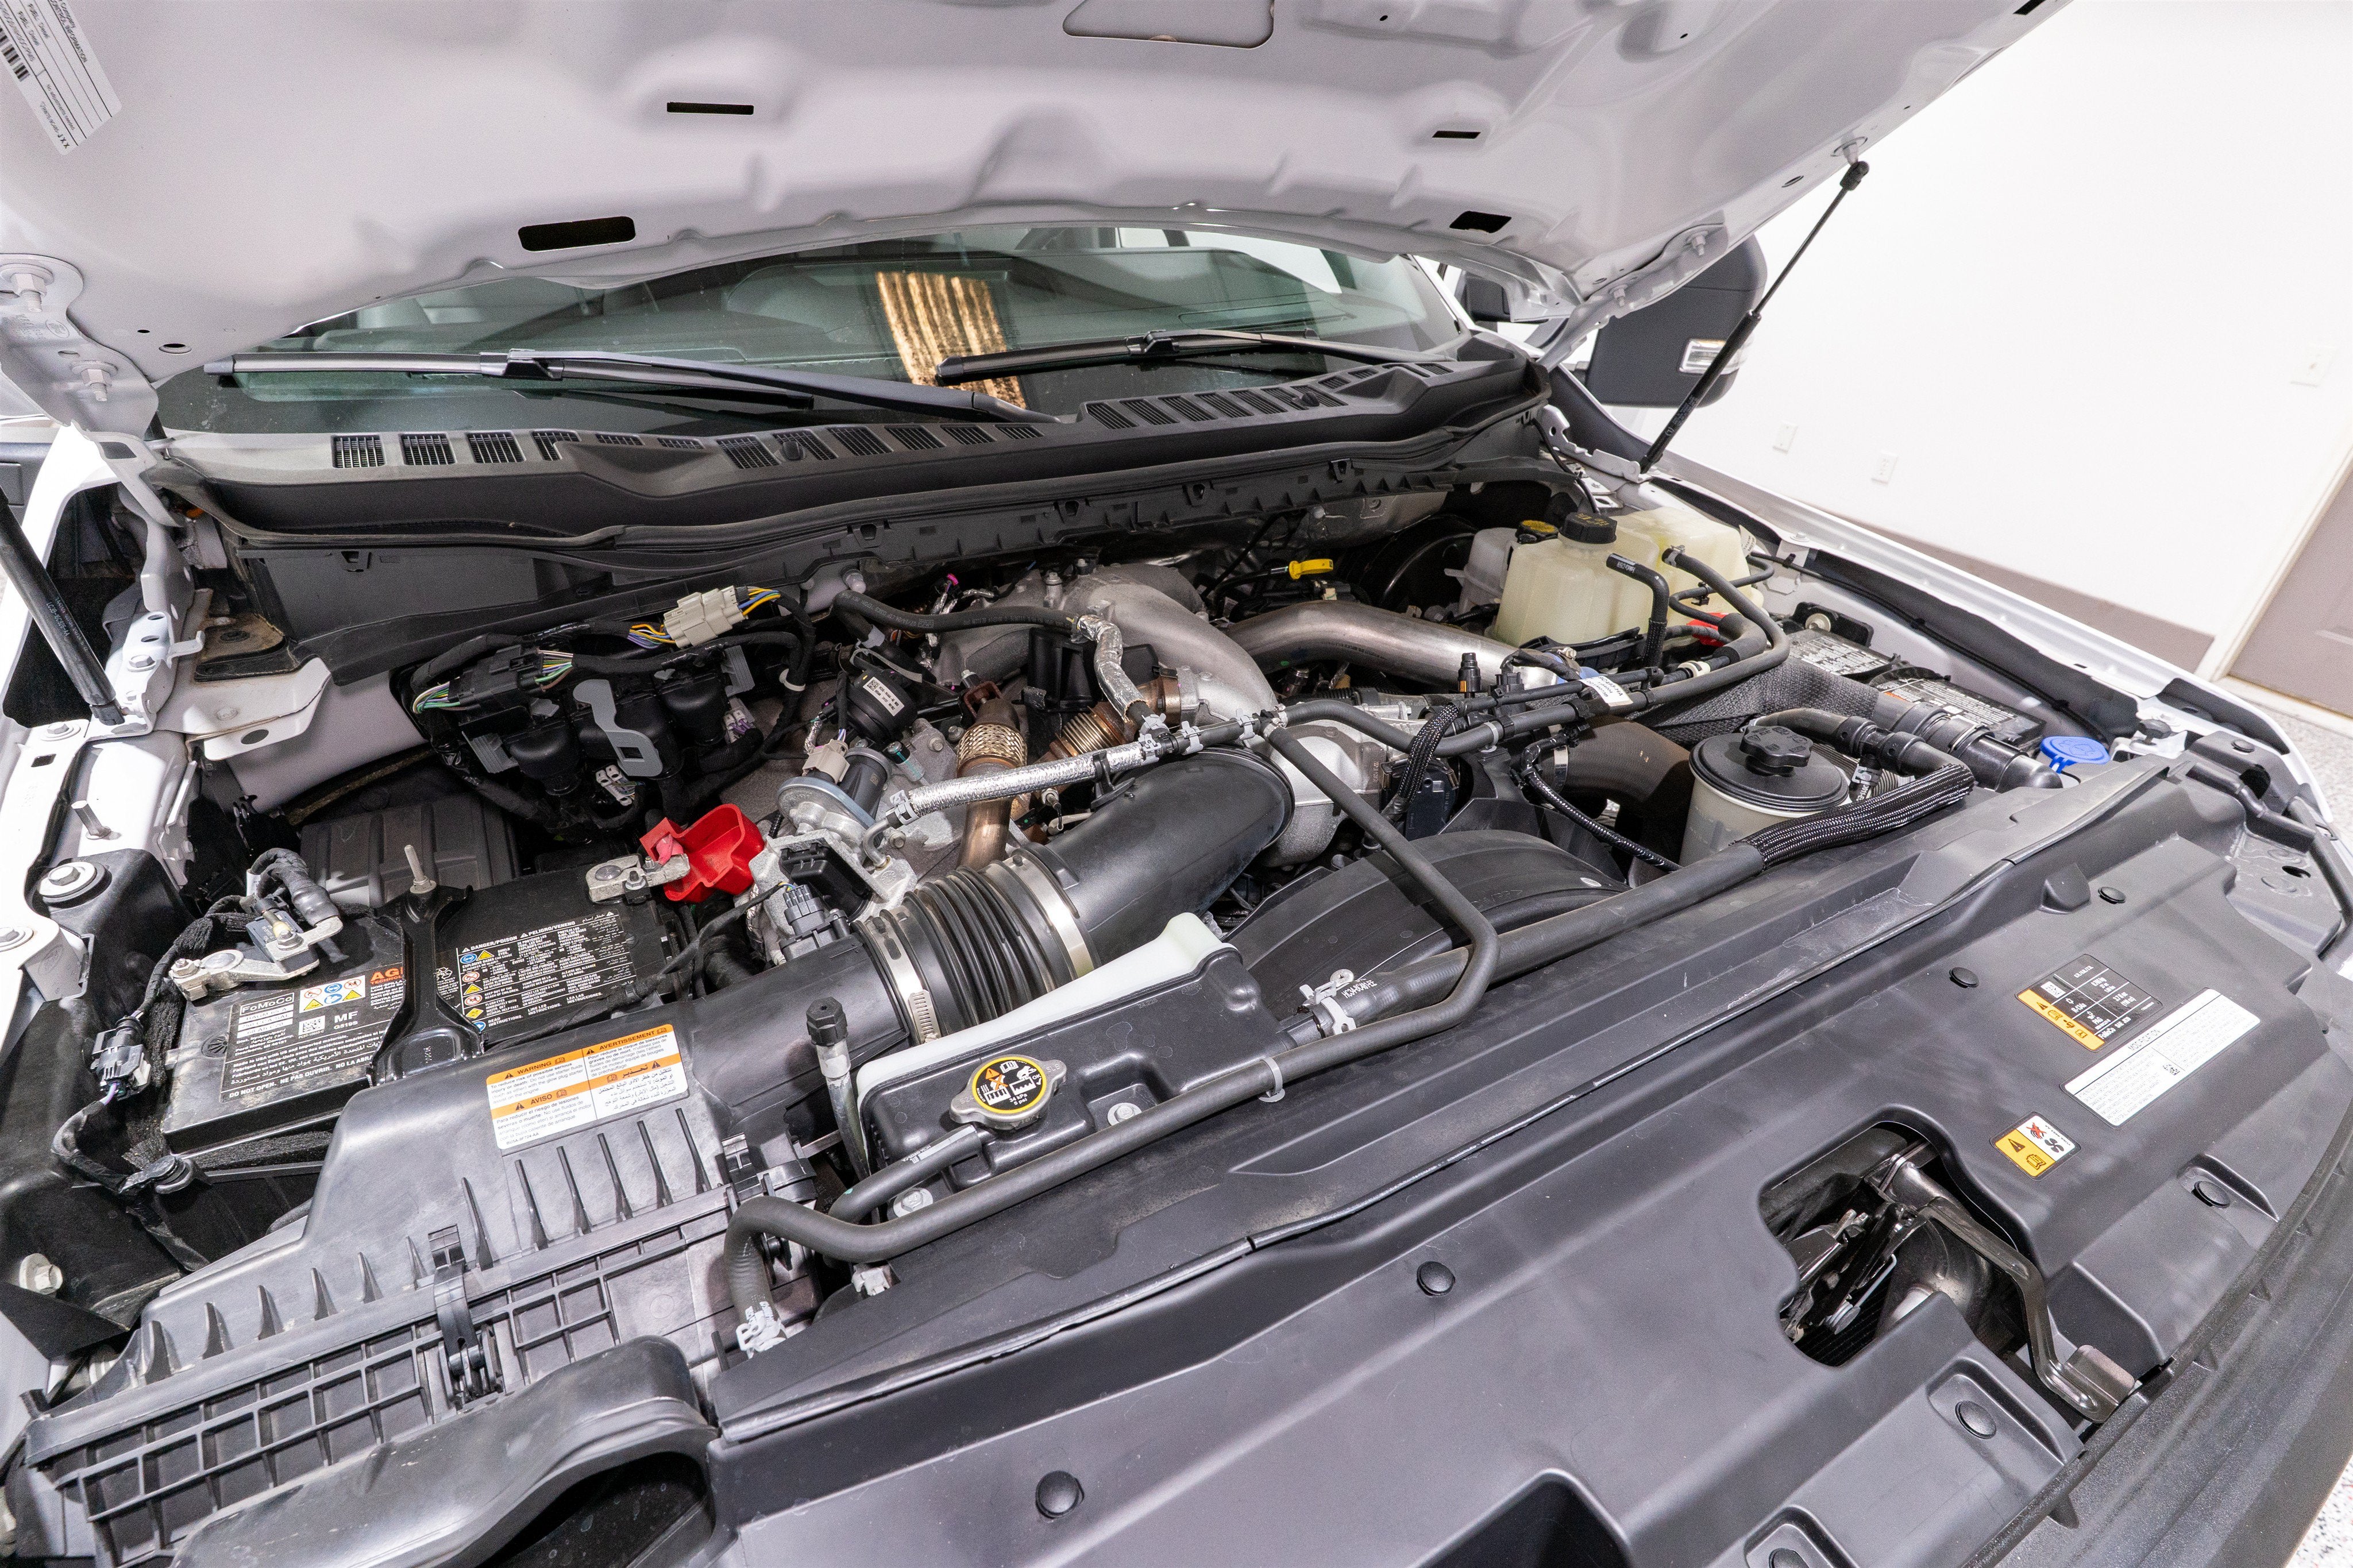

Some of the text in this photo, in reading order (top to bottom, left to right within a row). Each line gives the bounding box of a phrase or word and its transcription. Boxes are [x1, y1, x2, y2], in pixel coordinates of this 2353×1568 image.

[470, 921, 575, 950] DANGER/POISON PELIGRO/VENENO
[370, 967, 403, 982] AG
[566, 992, 603, 1003] INSTRUCCIONES.
[242, 997, 292, 1013] FoMoCo
[527, 1003, 561, 1015] INSTRUCTIONS.
[2070, 1003, 2087, 1013] R-134a
[334, 1010, 358, 1023] MF
[488, 1014, 523, 1026] INSTRUCTIONS.
[2091, 1016, 2103, 1025] PAG
[600, 1030, 654, 1049] AVERTISSEMENT
[645, 1034, 668, 1042] blessures
[517, 1061, 551, 1074] WARNING
[533, 1068, 553, 1077] possible
[240, 1087, 255, 1095] NOT
[256, 1082, 276, 1091] OPEN.
[290, 1073, 303, 1081] PAS
[304, 1066, 332, 1076] OUVRIR.
[530, 1094, 552, 1104] AVISO
[558, 1096, 579, 1104] lesiones
